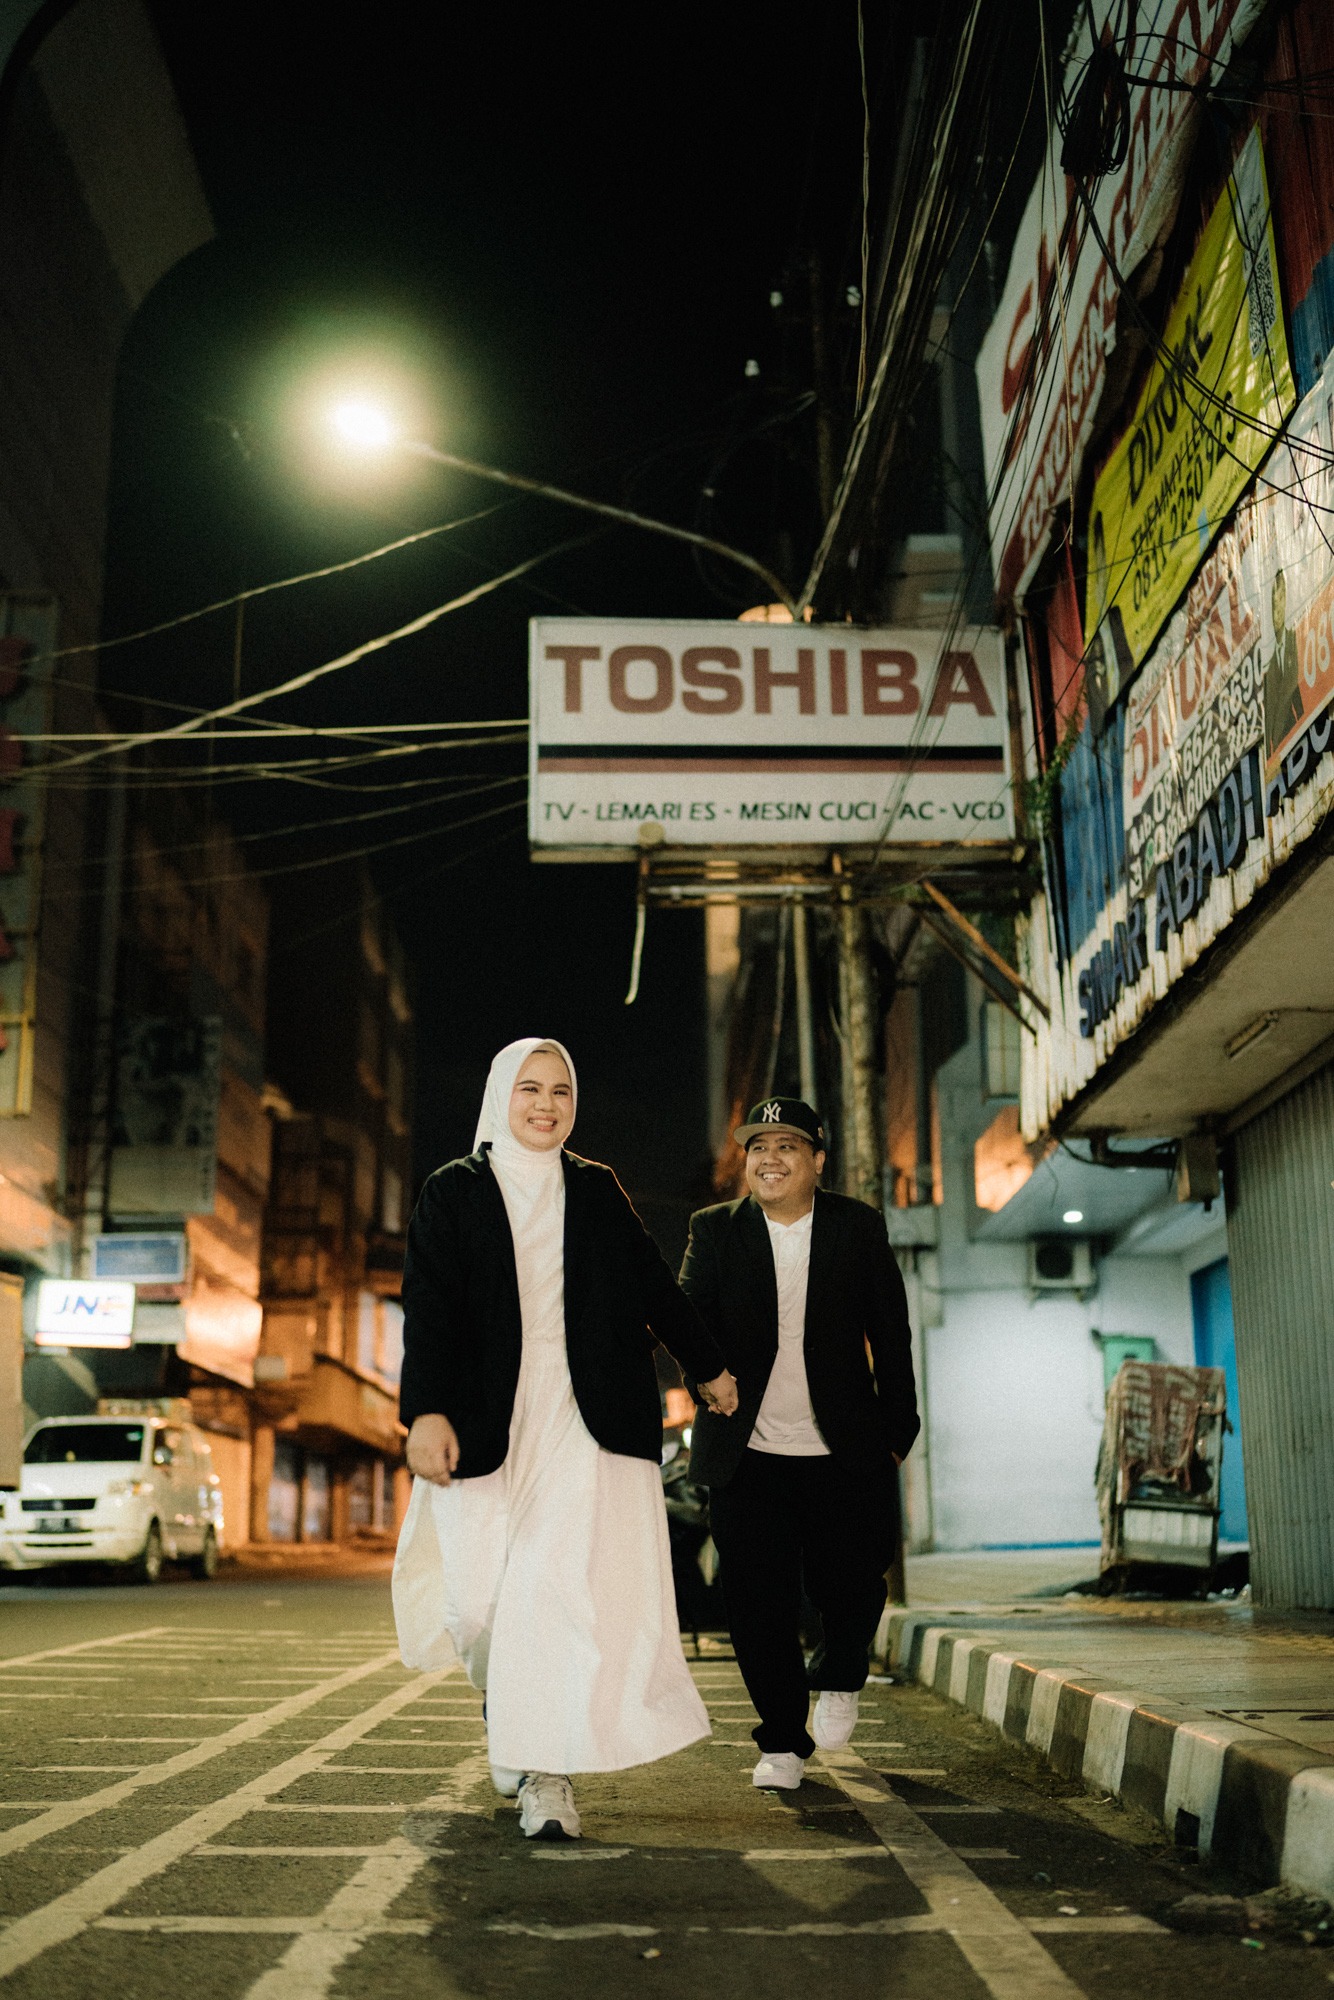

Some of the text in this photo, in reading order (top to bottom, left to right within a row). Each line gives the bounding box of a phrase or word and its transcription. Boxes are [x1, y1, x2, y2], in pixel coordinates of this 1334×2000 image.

[544, 645, 997, 717] TOSHIBA
[544, 802, 575, 820] TV
[596, 802, 682, 820] LEMARI
[690, 802, 717, 820] ES
[740, 802, 811, 820] MESIN
[819, 801, 877, 820] CUCI
[900, 801, 935, 820] AC
[953, 801, 1006, 820] VCD
[1078, 903, 1145, 1038] SINAR
[1154, 754, 1257, 950] ABADI
